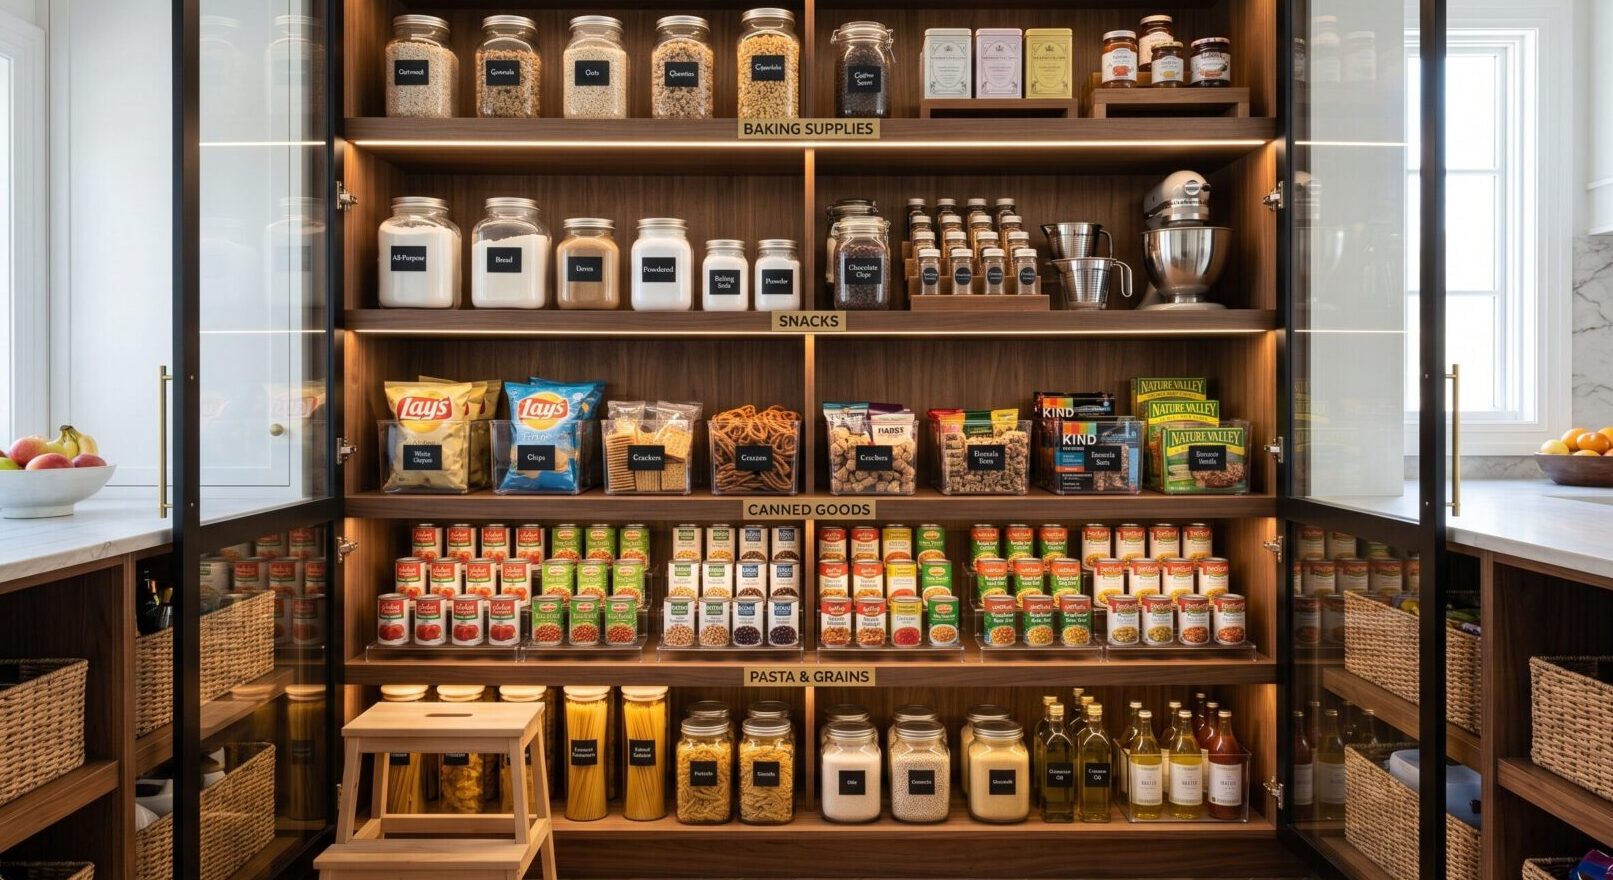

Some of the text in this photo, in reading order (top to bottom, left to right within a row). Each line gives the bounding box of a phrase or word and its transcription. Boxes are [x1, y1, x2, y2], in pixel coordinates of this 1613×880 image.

[744, 122, 873, 135] BAKING SUPPLIES
[779, 315, 839, 327] SNACKS
[1141, 379, 1174, 394] NATURE
[1174, 379, 1204, 393] VALLEY
[400, 396, 450, 420] Lay's
[519, 398, 567, 420] Lay's
[1042, 407, 1075, 418] KIND
[1152, 403, 1185, 418] NATURE
[1185, 403, 1217, 417] VALLEY
[1062, 433, 1097, 446] KIND
[1171, 430, 1241, 447] NATURE VALLEY
[748, 503, 871, 516] CANNED GOODS
[750, 670, 870, 683] PASTA & GRAINS
